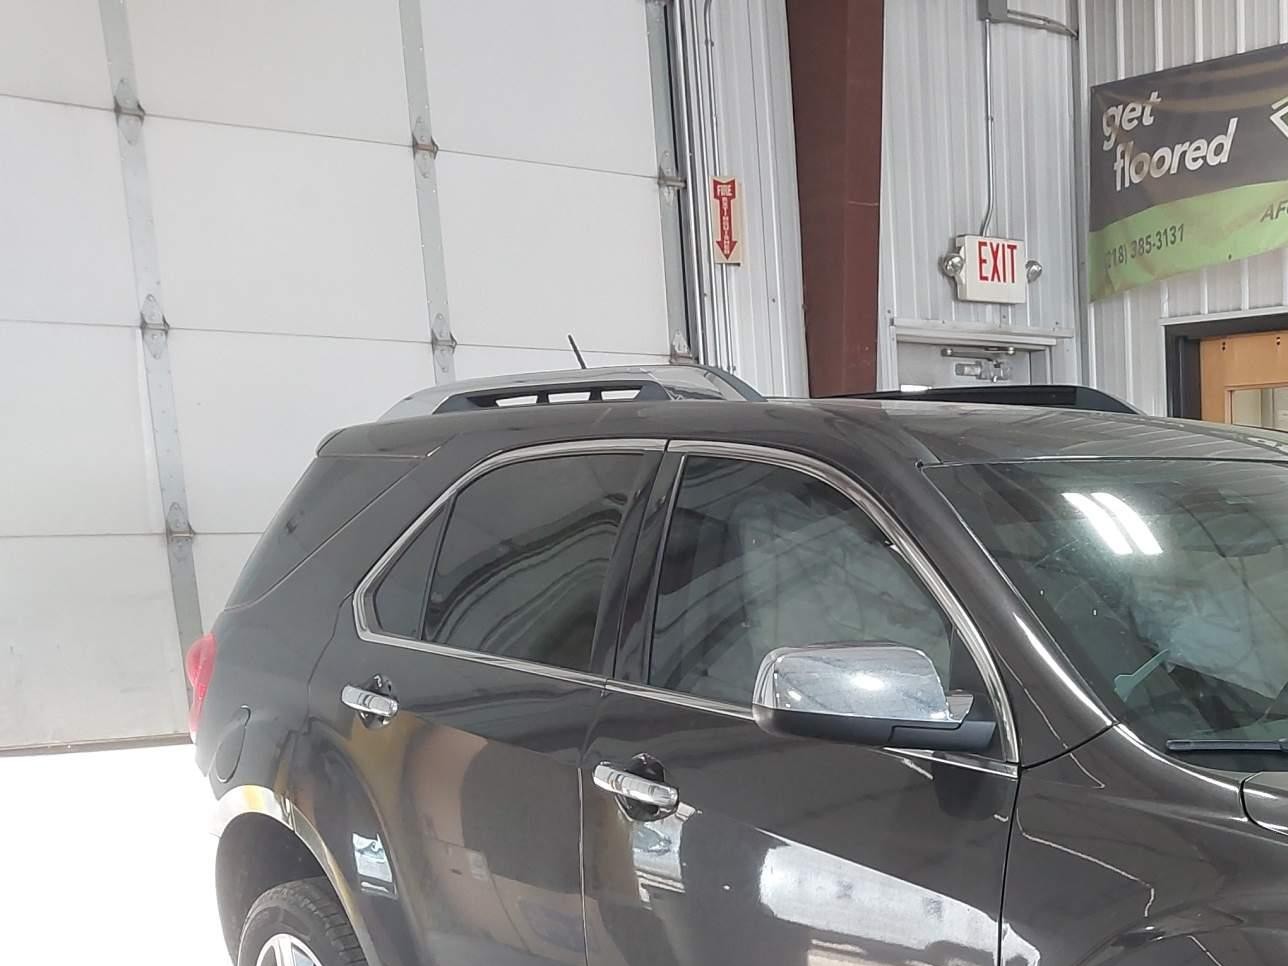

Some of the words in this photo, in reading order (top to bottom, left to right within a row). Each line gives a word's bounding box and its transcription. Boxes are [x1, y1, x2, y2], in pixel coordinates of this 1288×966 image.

[1102, 90, 1162, 151] get
[1113, 117, 1238, 192] floored
[978, 240, 1017, 283] EXIT
